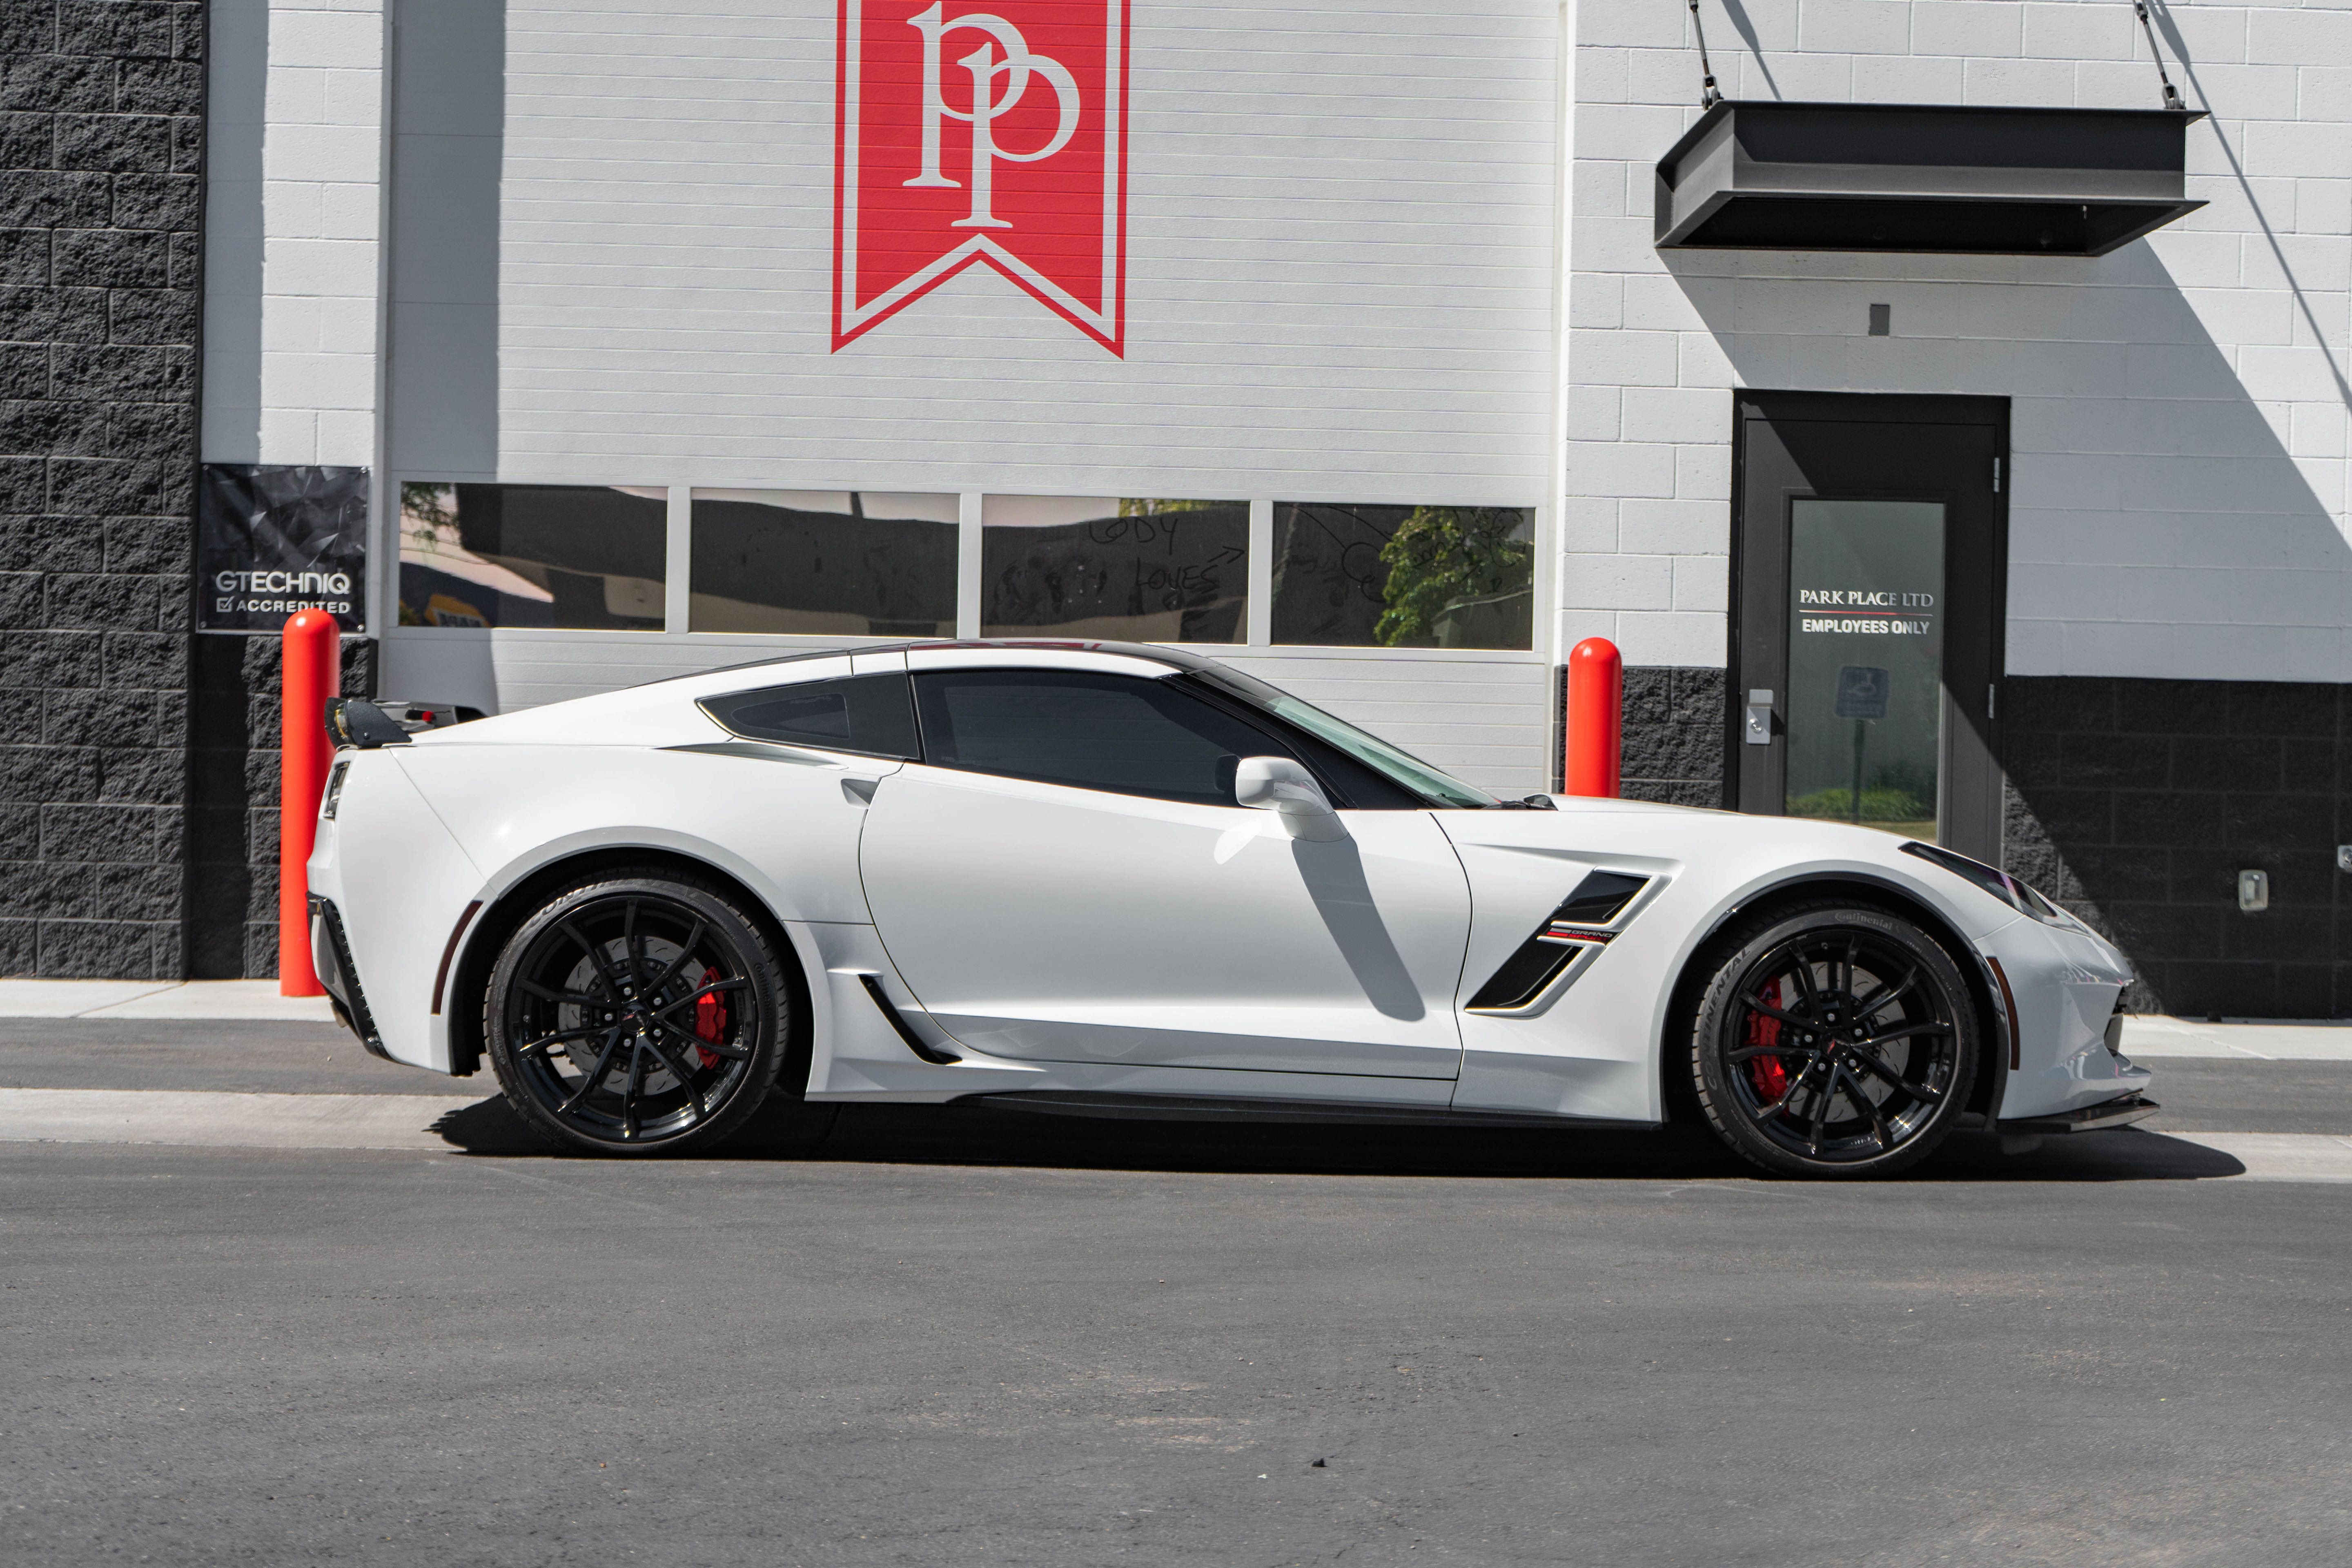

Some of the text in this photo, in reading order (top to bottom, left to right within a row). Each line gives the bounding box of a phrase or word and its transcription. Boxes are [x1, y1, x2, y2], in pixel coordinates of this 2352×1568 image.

[216, 570, 350, 595] GTECHNIQ
[236, 599, 350, 613] ACCREDITED
[1800, 590, 1934, 607] PARK PLACE LTD
[1802, 619, 1930, 635] EMPLOYEES ONLY
[1571, 930, 1613, 938] GRAND
